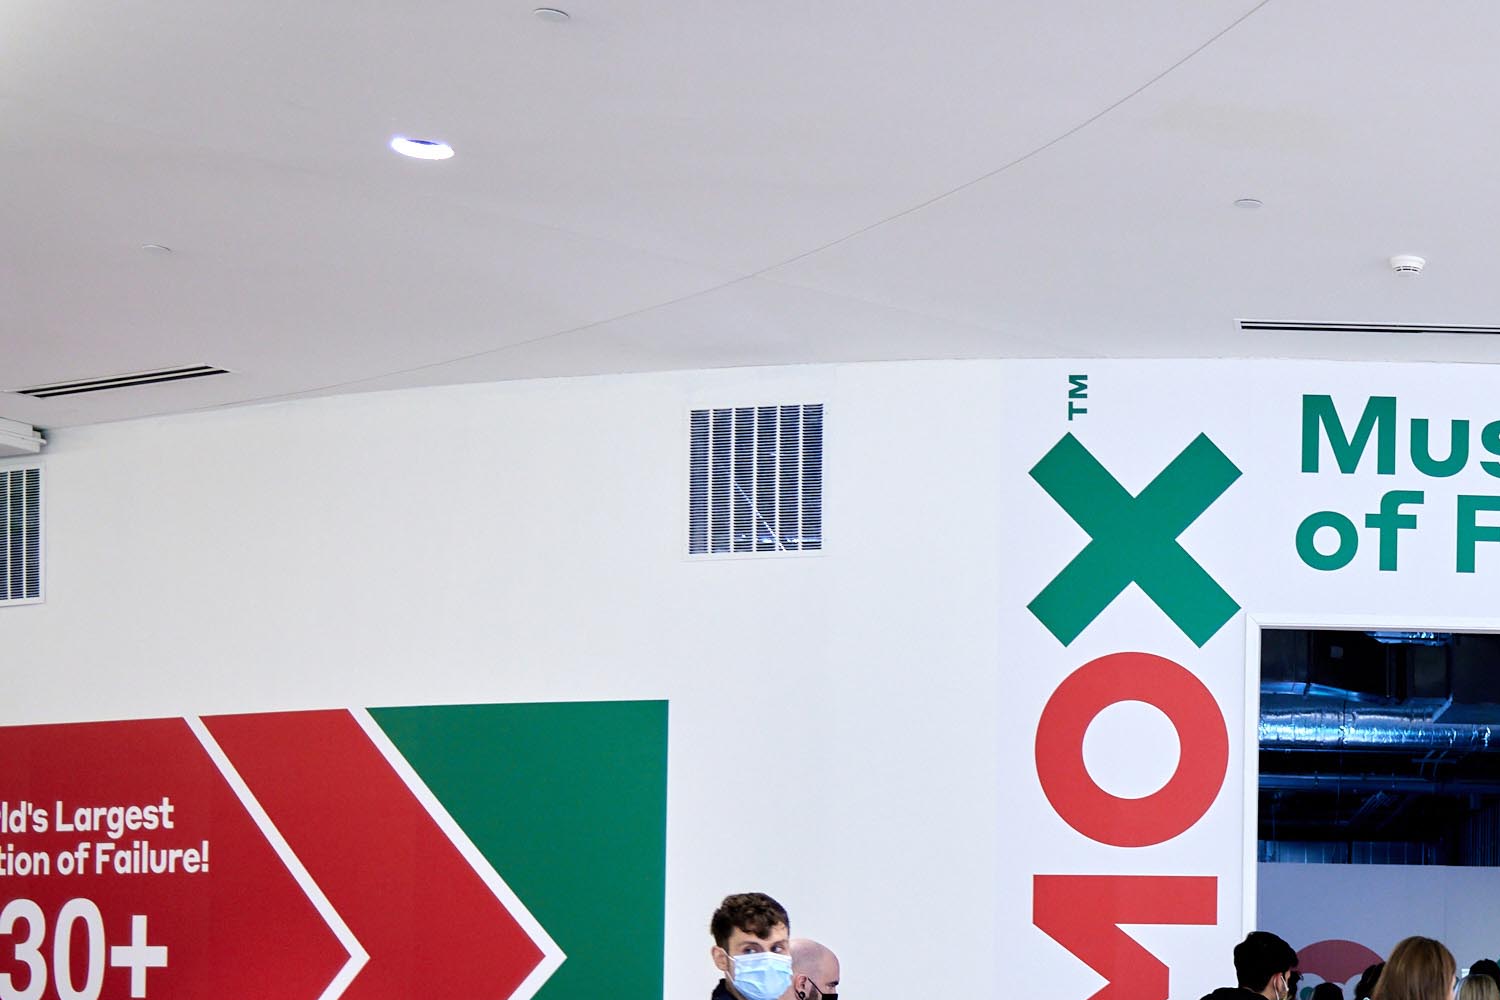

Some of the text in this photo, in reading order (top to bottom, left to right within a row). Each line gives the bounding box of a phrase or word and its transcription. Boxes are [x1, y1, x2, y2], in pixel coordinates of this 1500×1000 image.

[1296, 489, 1424, 572] of
[0, 797, 174, 839] ld's Largest
[57, 842, 91, 875] of
[95, 840, 209, 874] Failure!
